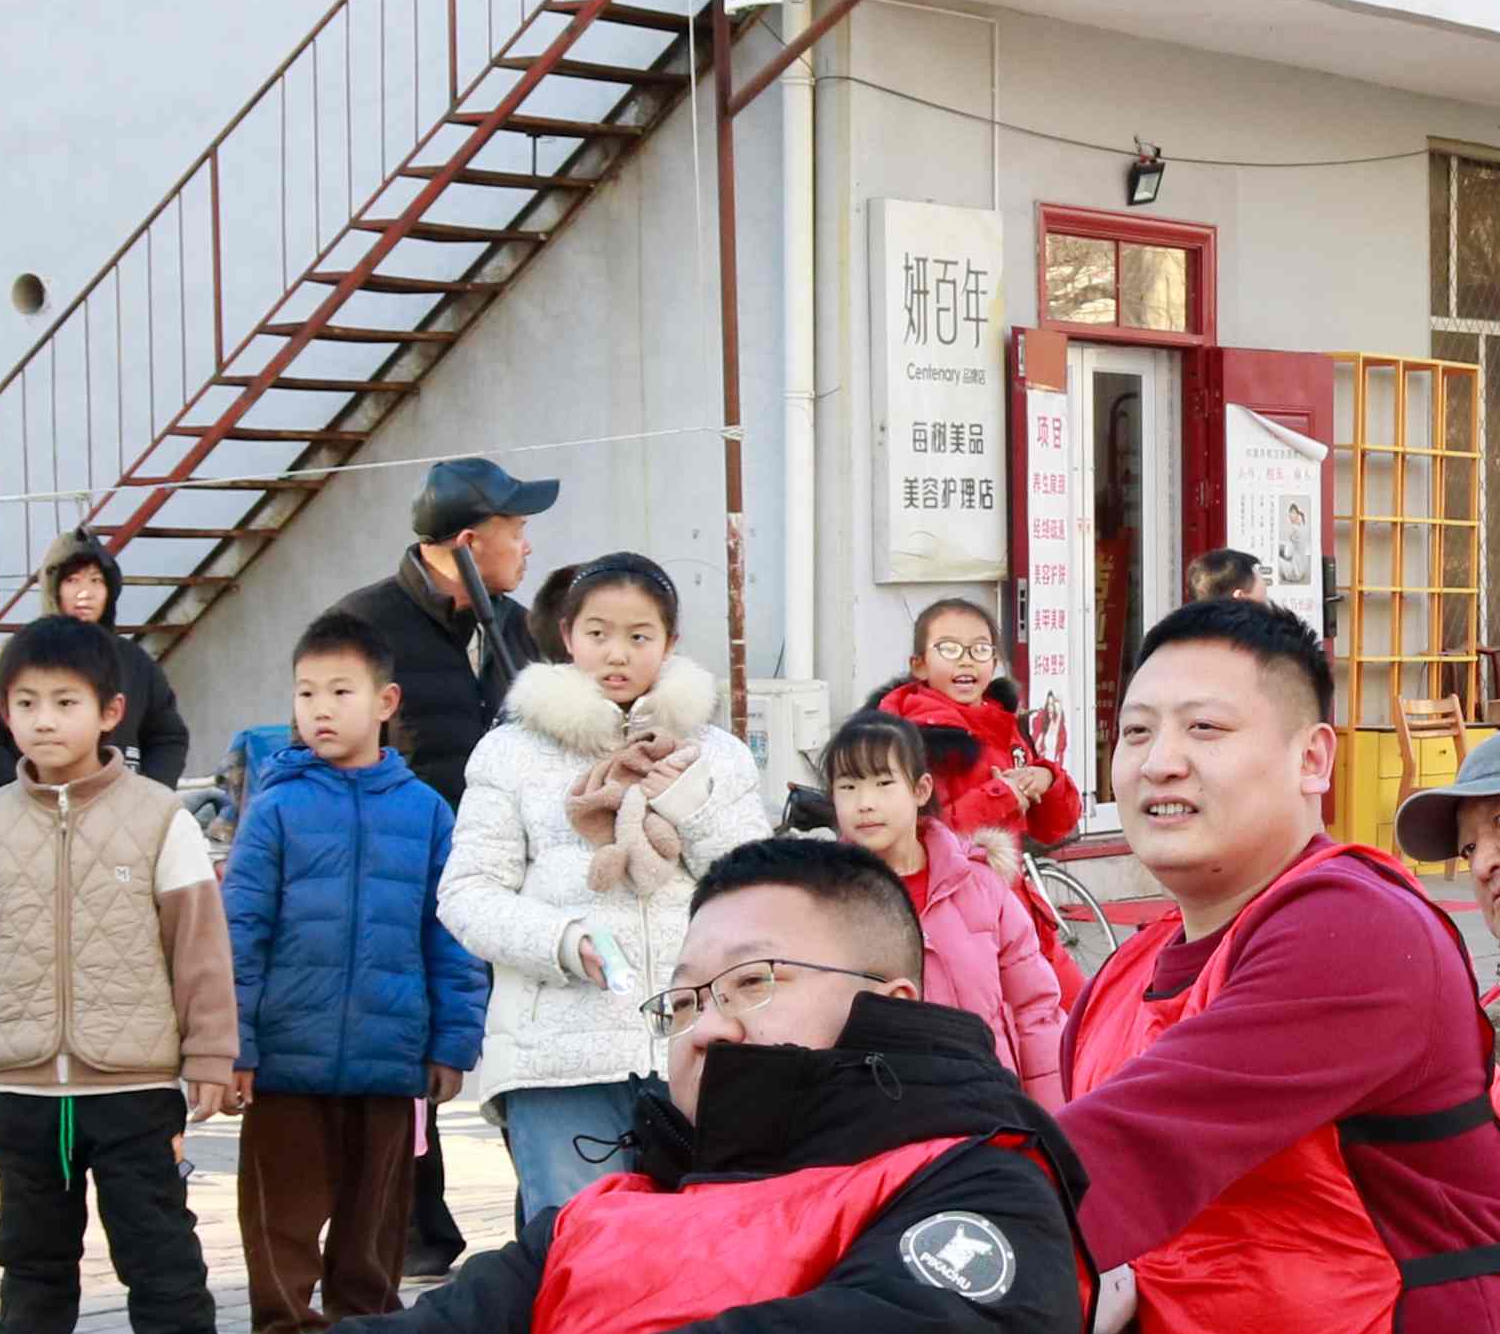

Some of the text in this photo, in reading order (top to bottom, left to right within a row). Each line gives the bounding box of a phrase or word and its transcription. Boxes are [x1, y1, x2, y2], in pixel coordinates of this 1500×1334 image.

[903, 252, 988, 348] 妍百年
[906, 362, 961, 386] Centenary
[911, 421, 985, 455] 每树美品
[1037, 415, 1062, 449] 项目
[903, 477, 994, 511] 美容护理店
[1034, 563, 1066, 585] 美容护肤
[920, 1252, 972, 1290] PIKACHU
